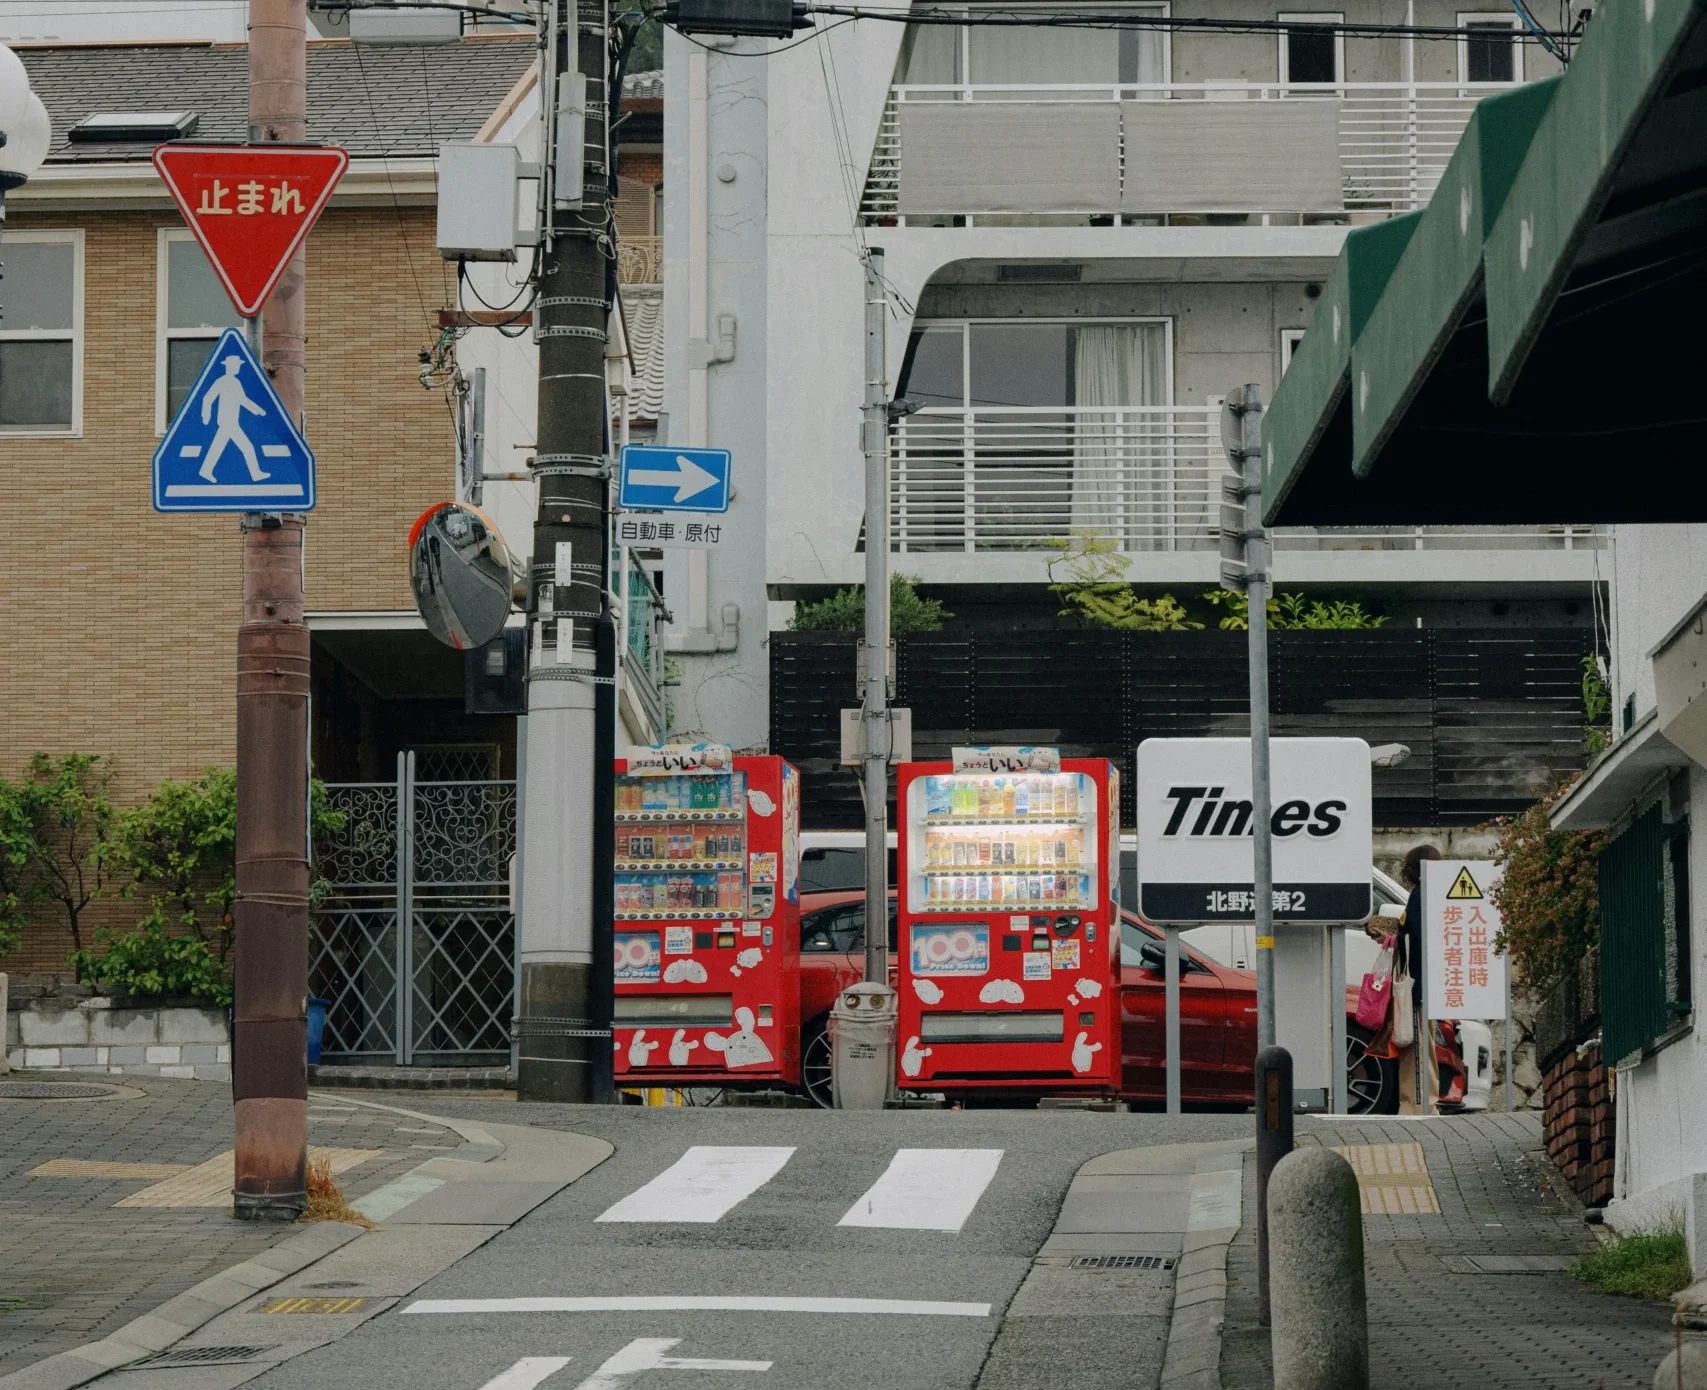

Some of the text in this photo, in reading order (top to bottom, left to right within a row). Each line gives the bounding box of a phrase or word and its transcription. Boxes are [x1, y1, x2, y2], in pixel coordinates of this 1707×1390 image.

[196, 179, 306, 216] 止まれ
[1443, 905, 1465, 1008] 歩行者注意
[1468, 905, 1488, 987] 入出庫時
